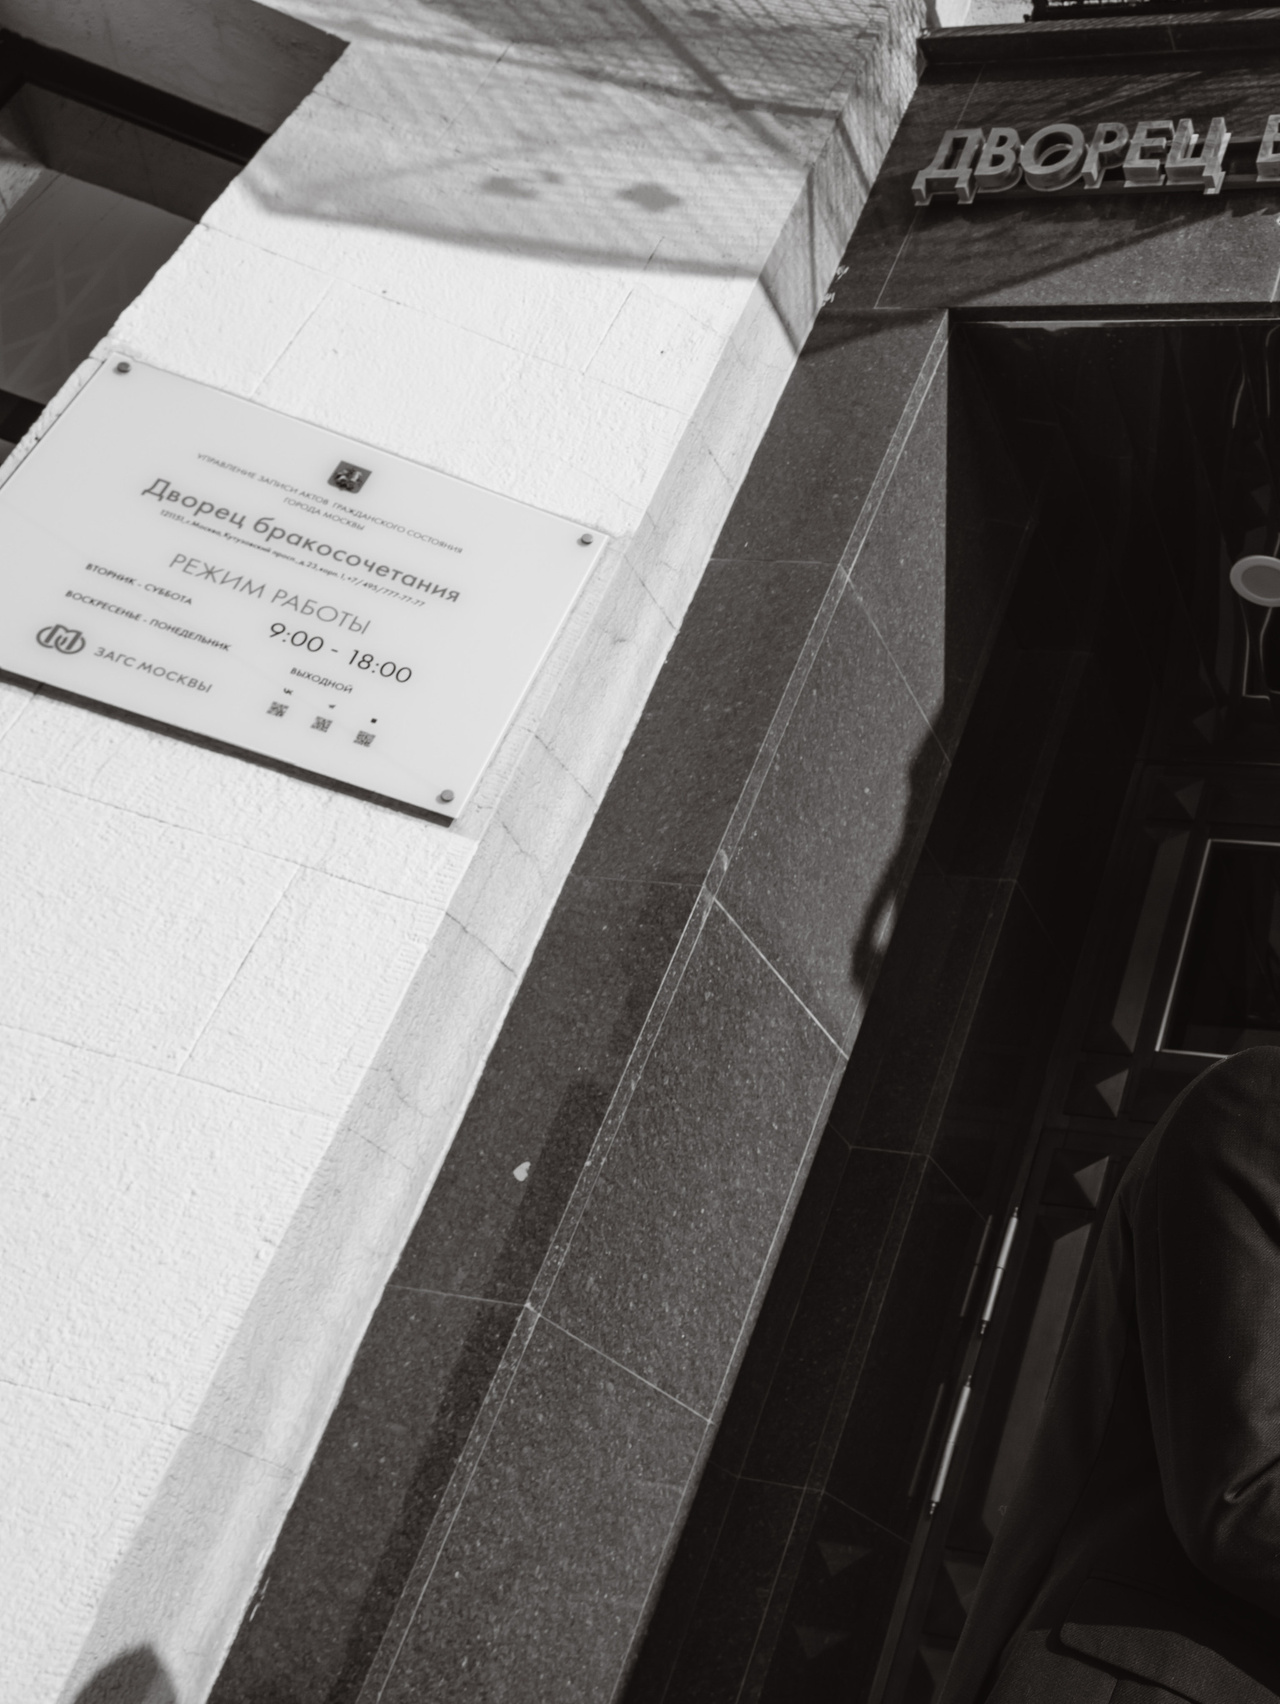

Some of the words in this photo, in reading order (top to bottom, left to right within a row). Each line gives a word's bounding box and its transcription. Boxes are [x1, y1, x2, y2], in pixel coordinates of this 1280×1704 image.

[911, 116, 1231, 206] ДВОРЕЦ
[140, 478, 246, 529] Дворец
[253, 517, 460, 603] бракосочетания
[197, 453, 257, 479] УПРАВЛЕНИЕ
[257, 475, 299, 494] ЗАПИСИ
[298, 491, 329, 505] АКТОВ
[332, 502, 406, 533] ГРАЖДАНСКОГО
[406, 529, 463, 554] СОСТОЯНИЯ
[283, 497, 321, 515] ГОРОДА
[322, 511, 365, 531] МОСКВЫ
[85, 563, 137, 586] ВТОРНИК
[144, 583, 192, 605] СУББОТА
[269, 622, 324, 652] 9:00
[348, 649, 412, 683] 18:00
[169, 553, 266, 599] РЕЖИМ
[270, 588, 371, 635] РАБОТЫ
[65, 590, 142, 621] ВОСКРЕСЕНЬЕ
[149, 618, 231, 652] ПОНЕДЕЛЬНИК
[290, 667, 353, 694] ВЫХОДНОЙ
[93, 646, 137, 667] ЗАГС
[136, 661, 213, 693] МОСКВЫ
